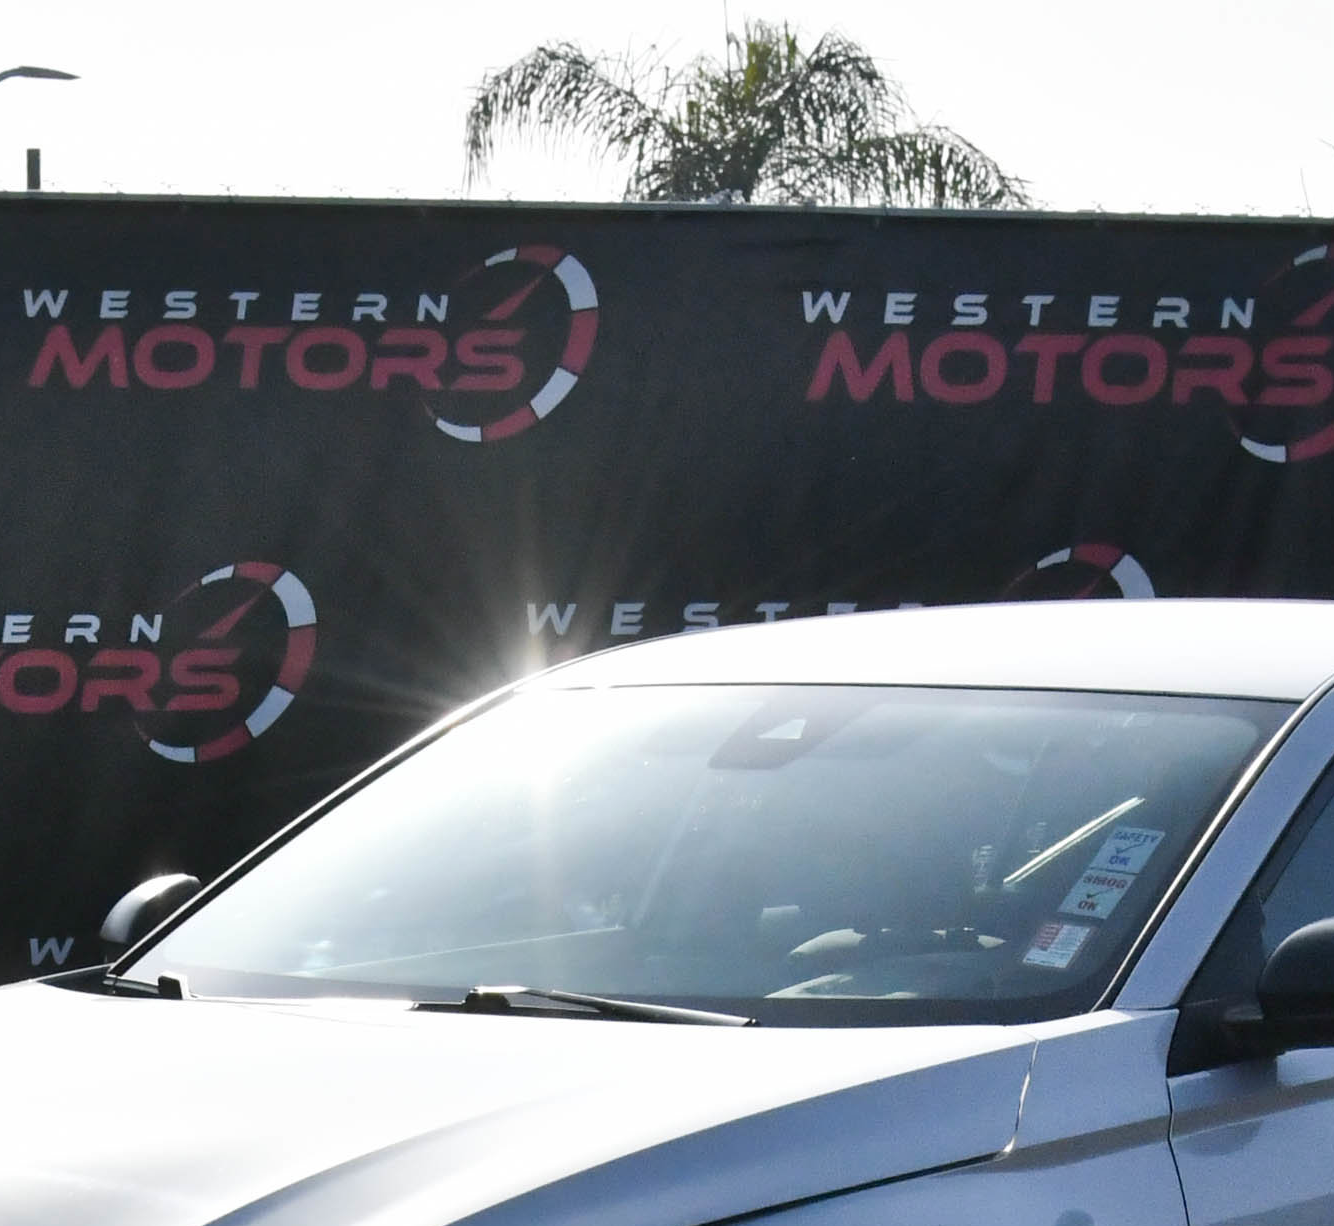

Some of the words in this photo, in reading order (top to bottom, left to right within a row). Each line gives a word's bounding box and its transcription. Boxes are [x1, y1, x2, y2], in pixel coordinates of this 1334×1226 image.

[22, 289, 450, 323] WESTERN
[801, 291, 1255, 329] WESTERN
[28, 324, 524, 391] MOTORS
[527, 602, 923, 635] WEST
[1108, 855, 1131, 866] OK
[1082, 875, 1128, 889] SMOG
